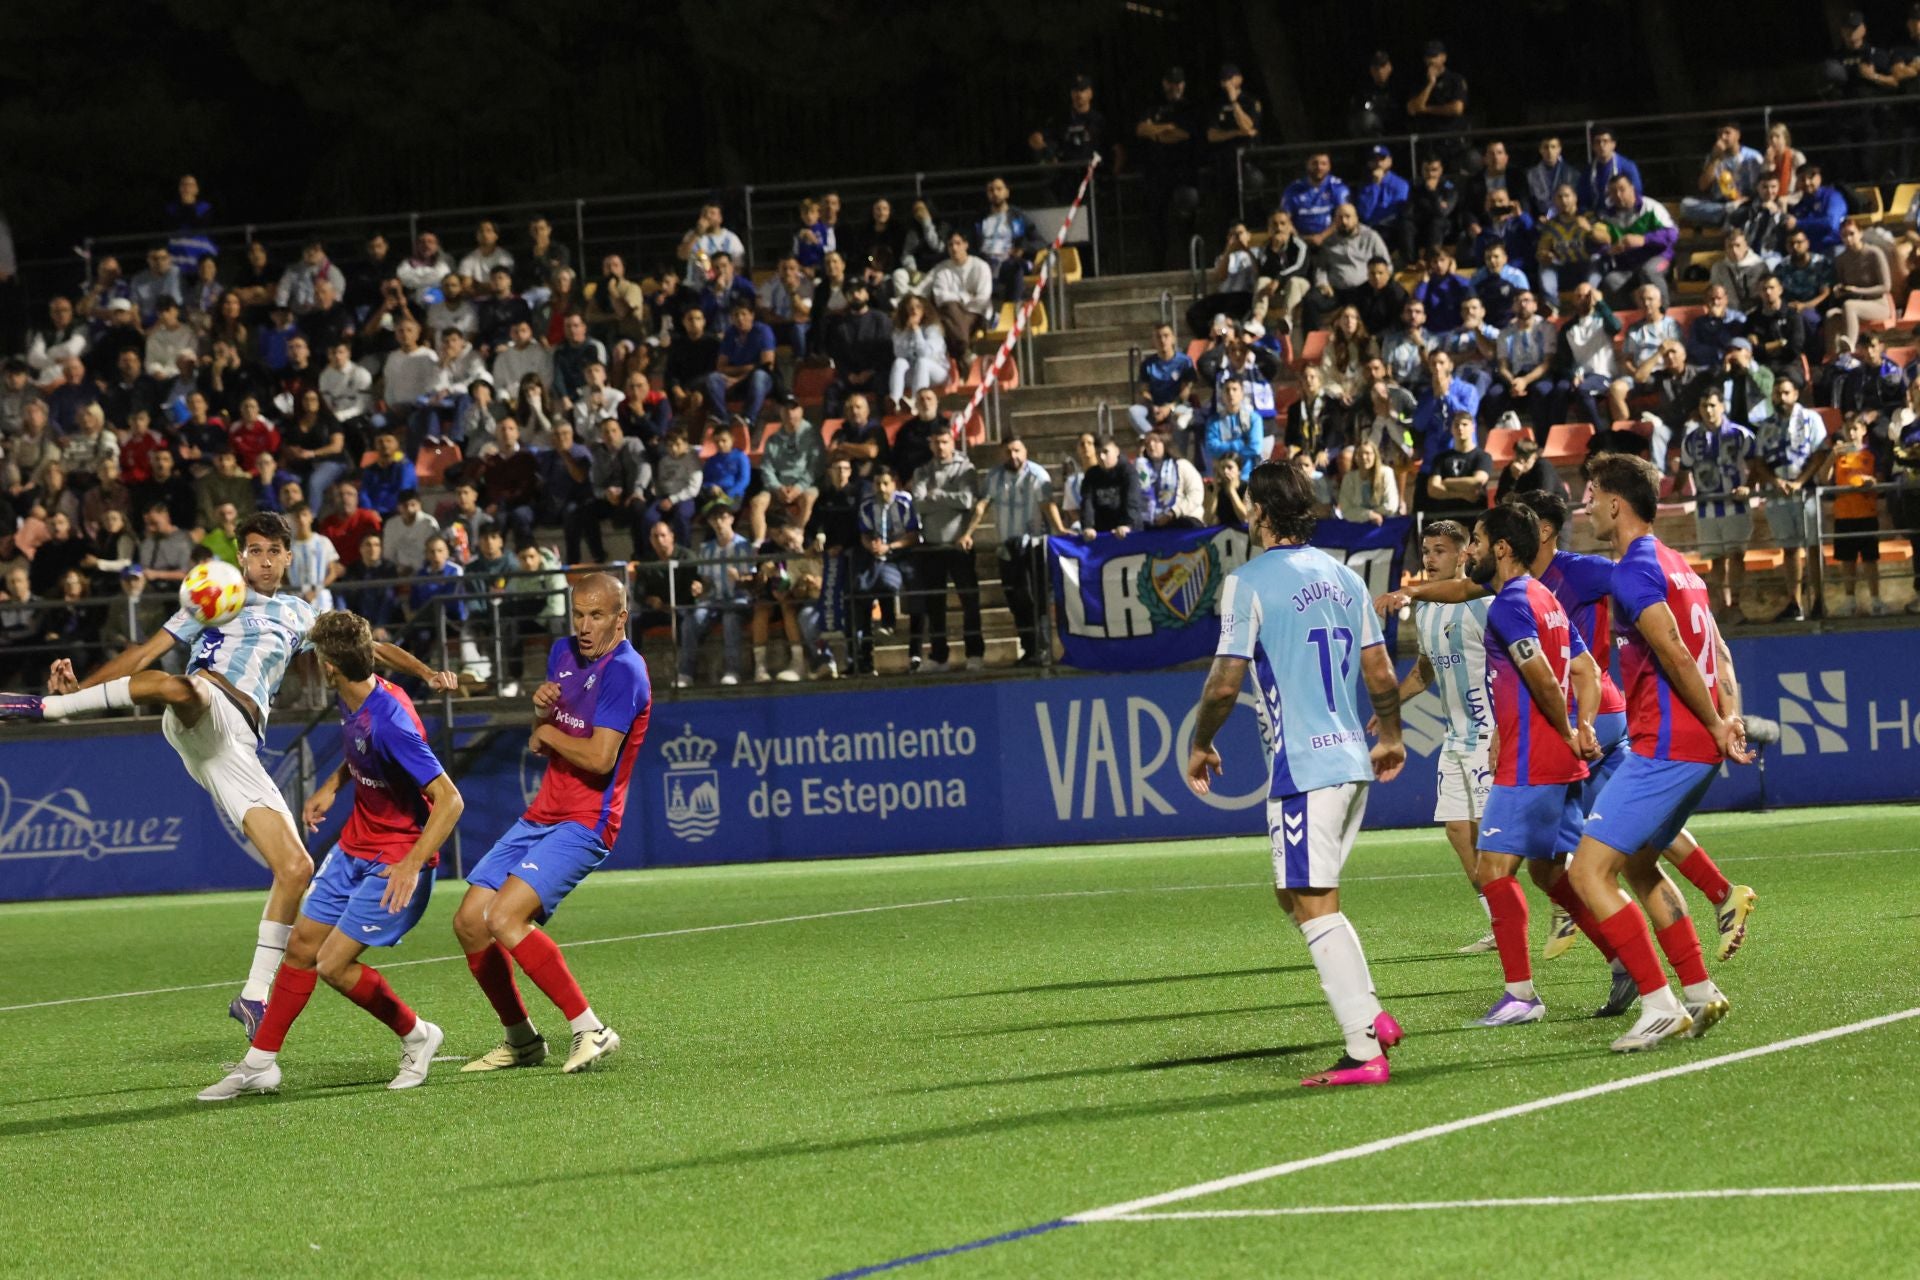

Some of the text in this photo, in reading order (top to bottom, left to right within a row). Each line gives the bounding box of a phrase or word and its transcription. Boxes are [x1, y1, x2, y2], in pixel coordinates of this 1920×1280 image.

[1306, 626, 1354, 713] 17
[1516, 639, 1534, 660] C
[1466, 687, 1489, 728] UAX
[1868, 699, 1920, 751] H
[731, 721, 977, 775] Ayuntamiento
[748, 777, 967, 819] de Estepona
